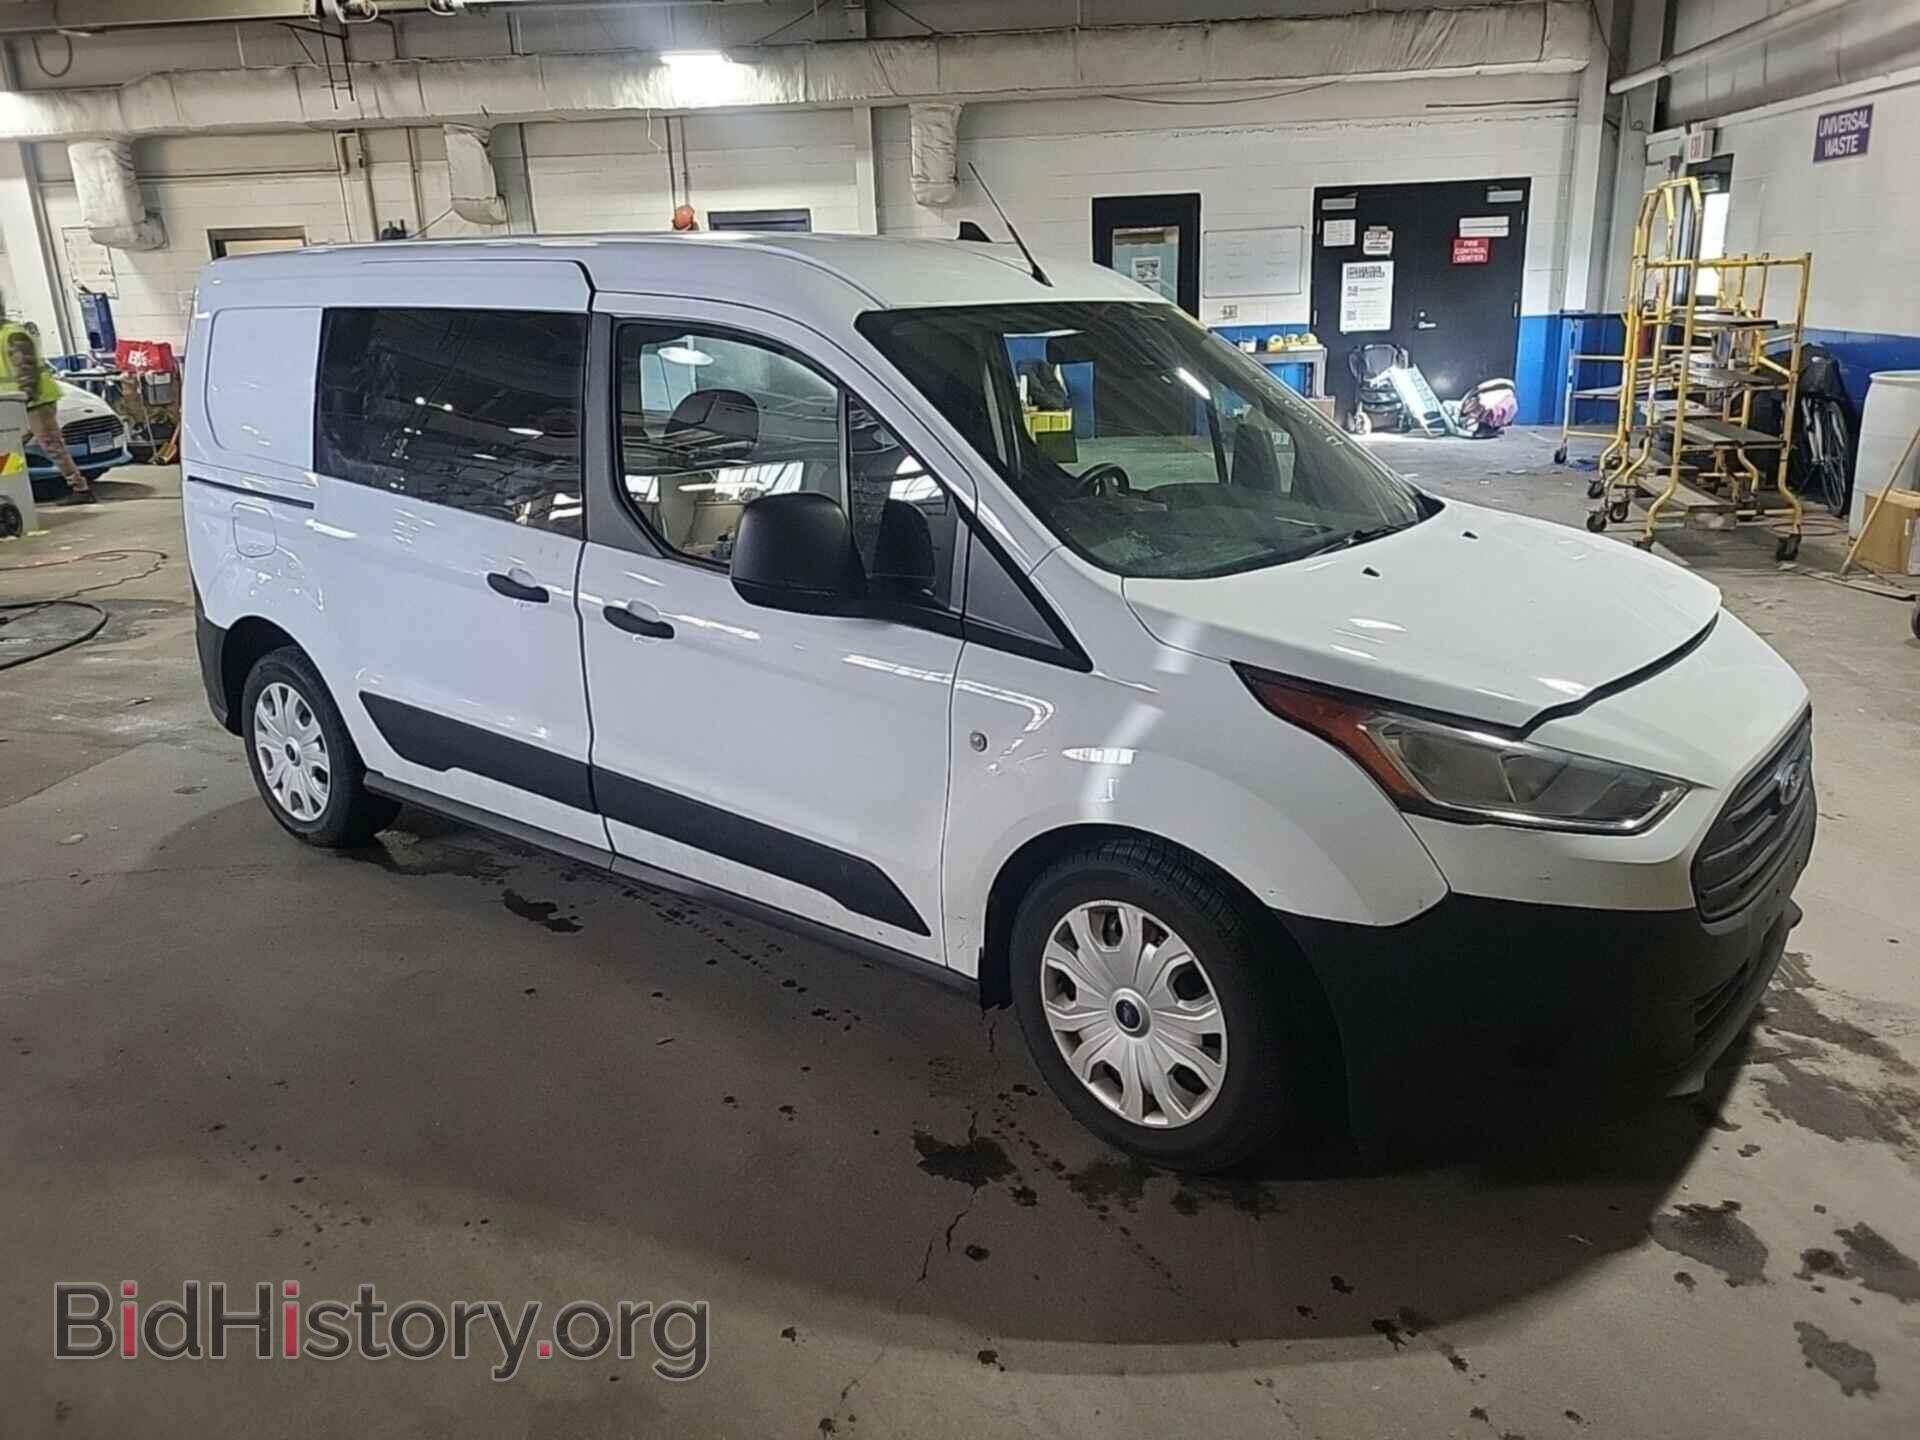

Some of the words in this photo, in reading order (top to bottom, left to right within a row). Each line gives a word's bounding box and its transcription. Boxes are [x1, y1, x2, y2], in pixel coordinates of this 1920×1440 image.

[1819, 109, 1869, 137] UNIVERSAL
[1824, 133, 1859, 157] WASTE
[1456, 254, 1485, 263] CENTER
